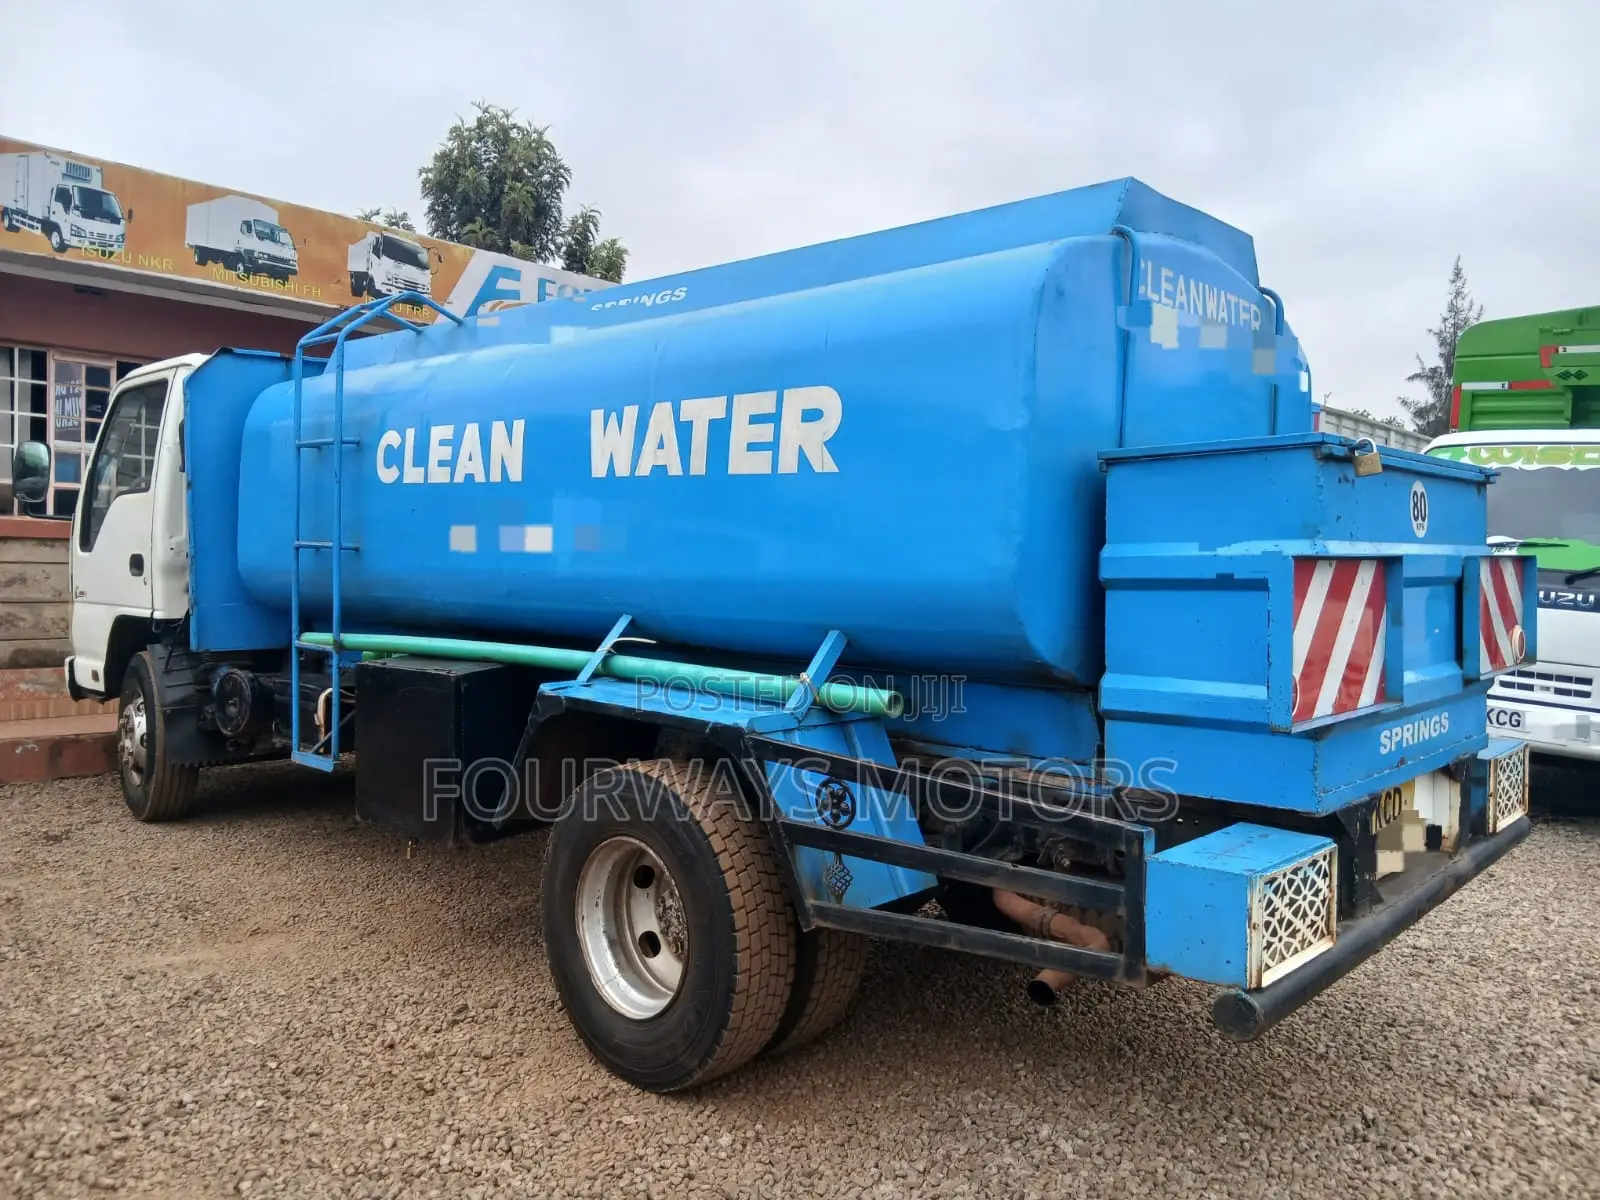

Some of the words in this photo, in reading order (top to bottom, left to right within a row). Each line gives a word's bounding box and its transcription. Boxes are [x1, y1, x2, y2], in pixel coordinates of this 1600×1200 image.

[82, 245, 132, 264] ISUZU
[138, 254, 174, 271] NKR
[212, 267, 298, 294] MITSUBISHI
[303, 285, 321, 298] FH
[376, 419, 525, 484] CLEAN
[590, 385, 842, 479] WATER
[1412, 490, 1427, 522] 80
[1538, 591, 1595, 608] UZU
[1379, 712, 1449, 754] SPRINGS
[1487, 707, 1522, 728] KCG
